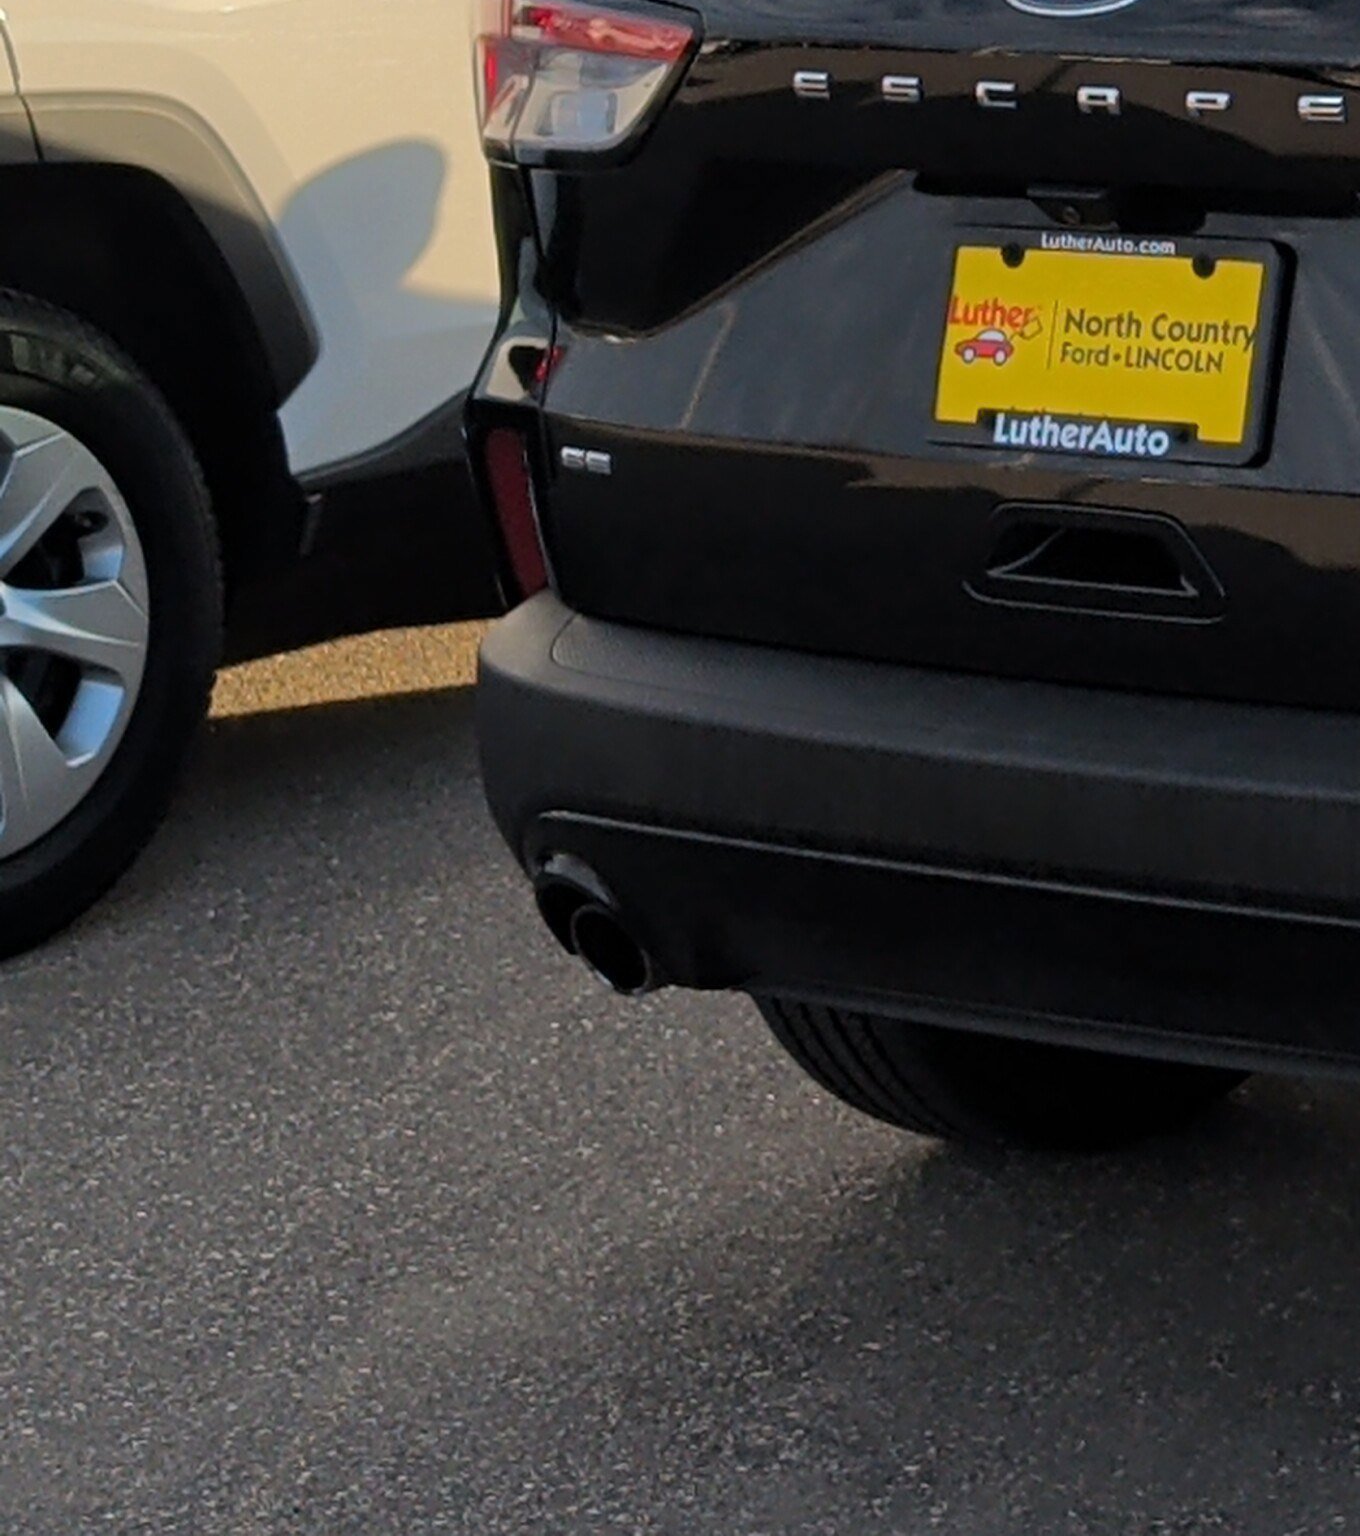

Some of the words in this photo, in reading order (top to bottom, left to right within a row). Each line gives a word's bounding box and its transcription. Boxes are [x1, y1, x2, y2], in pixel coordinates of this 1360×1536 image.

[793, 70, 1347, 123] ESCAPE
[1040, 232, 1176, 256] LutherAuto.com
[949, 296, 1036, 328] Luther
[1064, 308, 1143, 339] North
[1151, 313, 1256, 353] Country
[993, 412, 1170, 456] LutherAuto
[561, 446, 612, 476] SE
